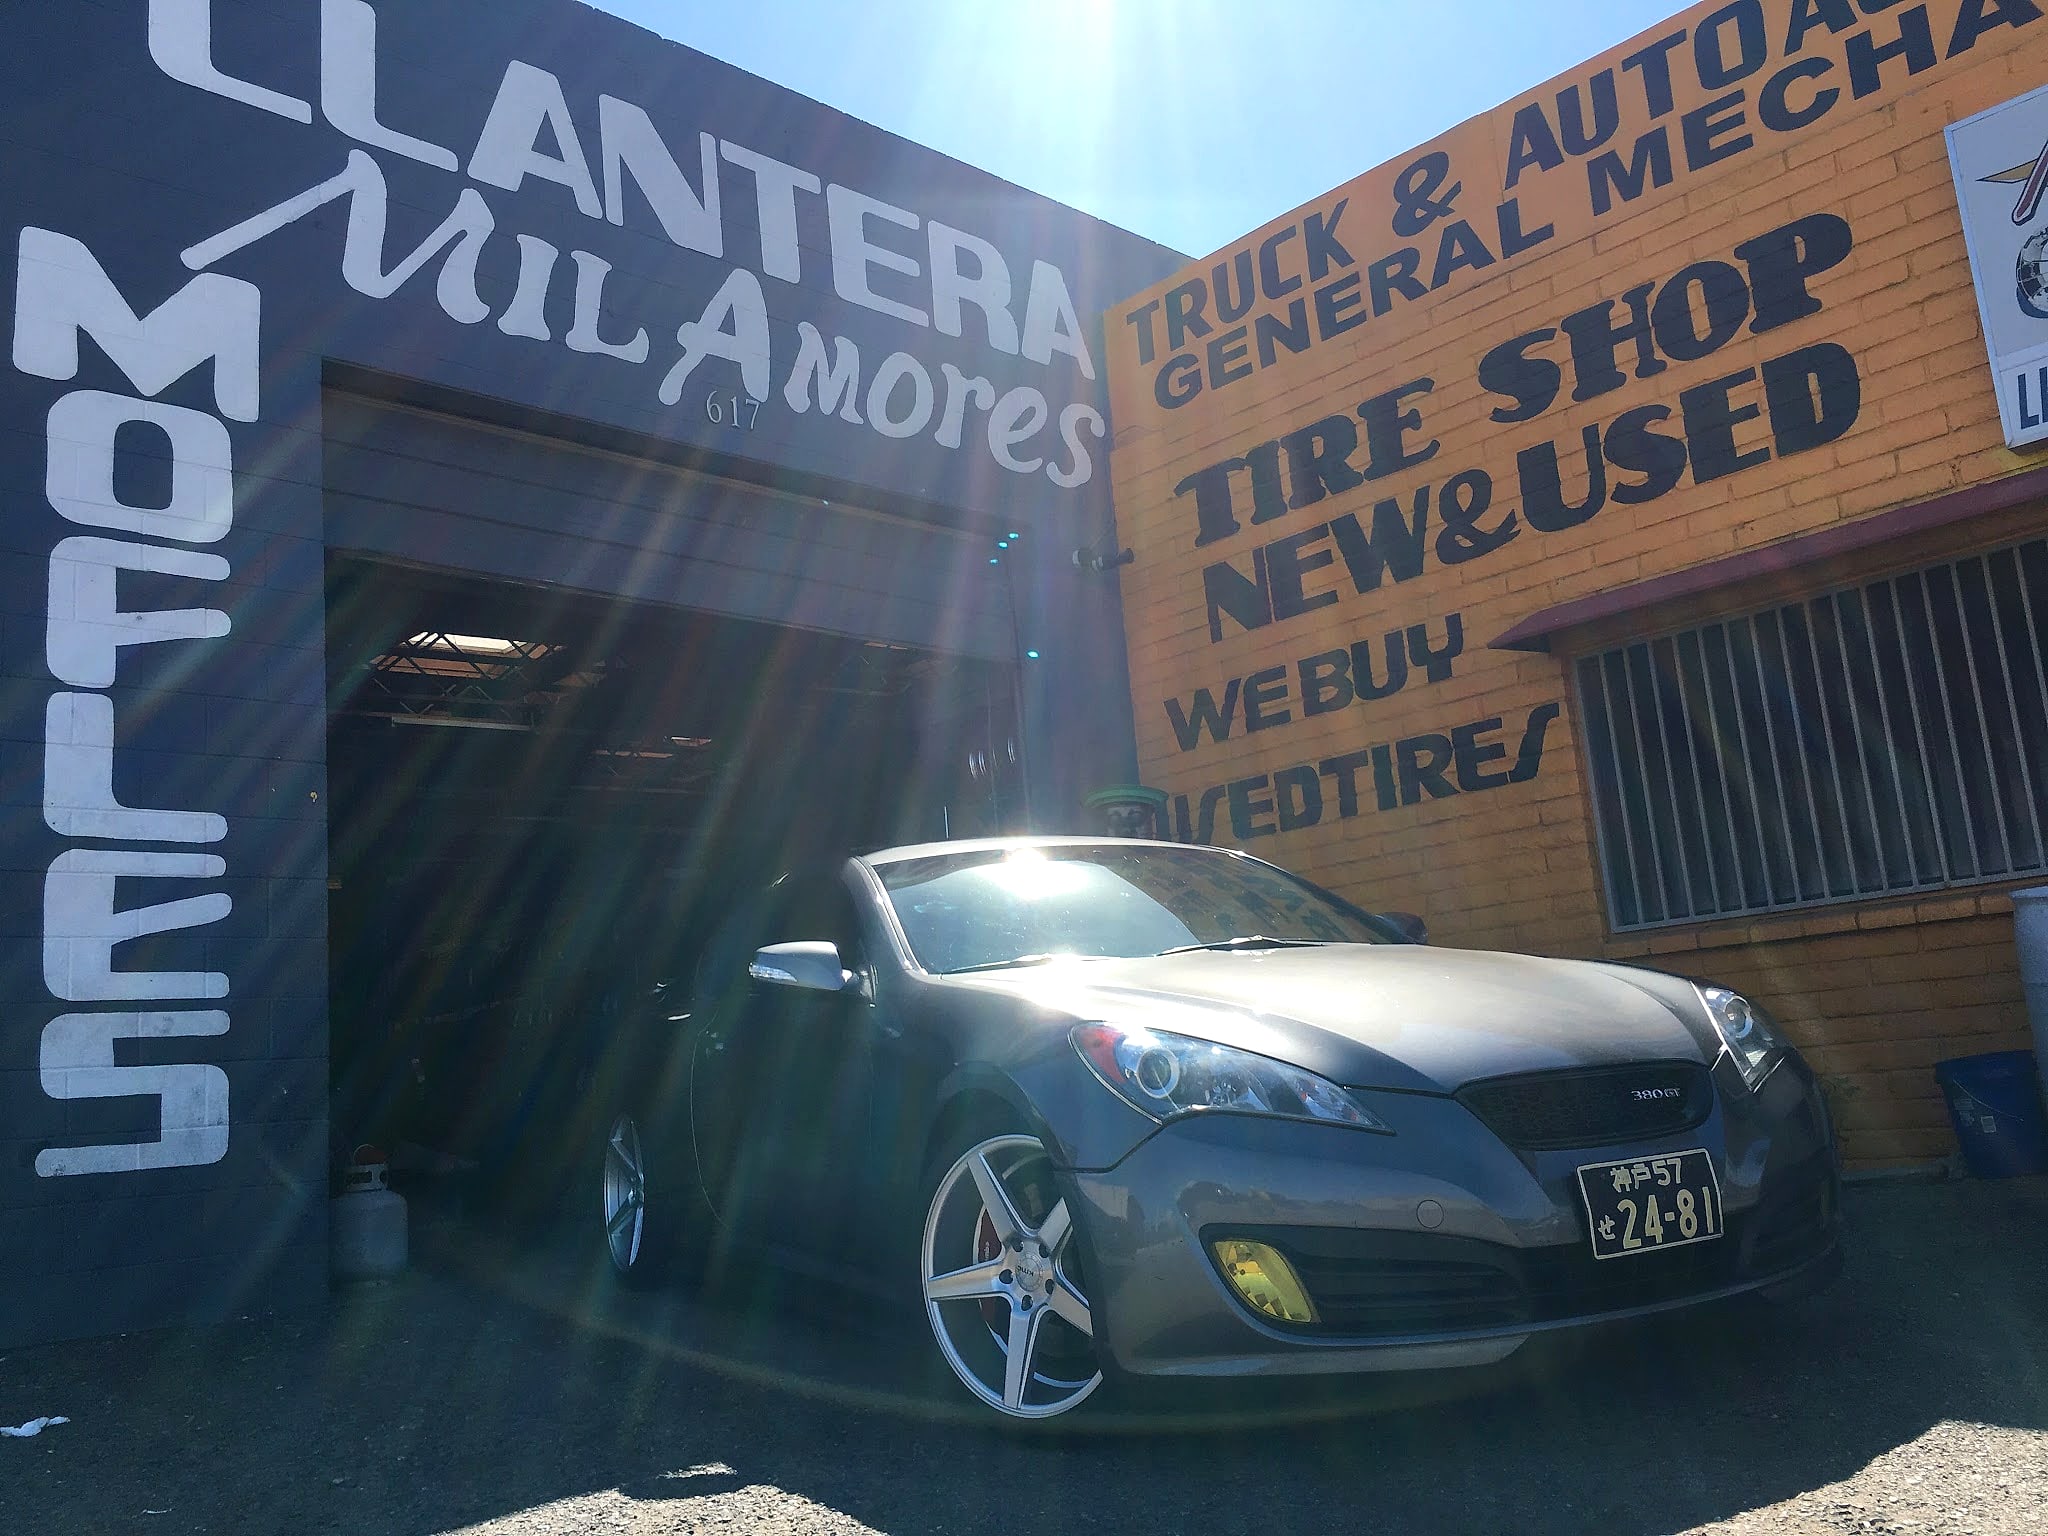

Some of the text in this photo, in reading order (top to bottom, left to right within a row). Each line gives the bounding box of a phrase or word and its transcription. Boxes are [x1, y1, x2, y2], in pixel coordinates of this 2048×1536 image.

[149, 0, 1095, 380] LLANTERA
[1127, 198, 1355, 366] TRUCK
[1392, 151, 1461, 238] &
[1504, 0, 1767, 190] AUTO
[1154, 198, 1555, 409] GENERAL
[706, 390, 760, 430] 617
[1174, 213, 1852, 548] TIRE SHOP
[13, 226, 260, 1178] MOFLES
[1617, 1187, 1714, 1249] 24-81
